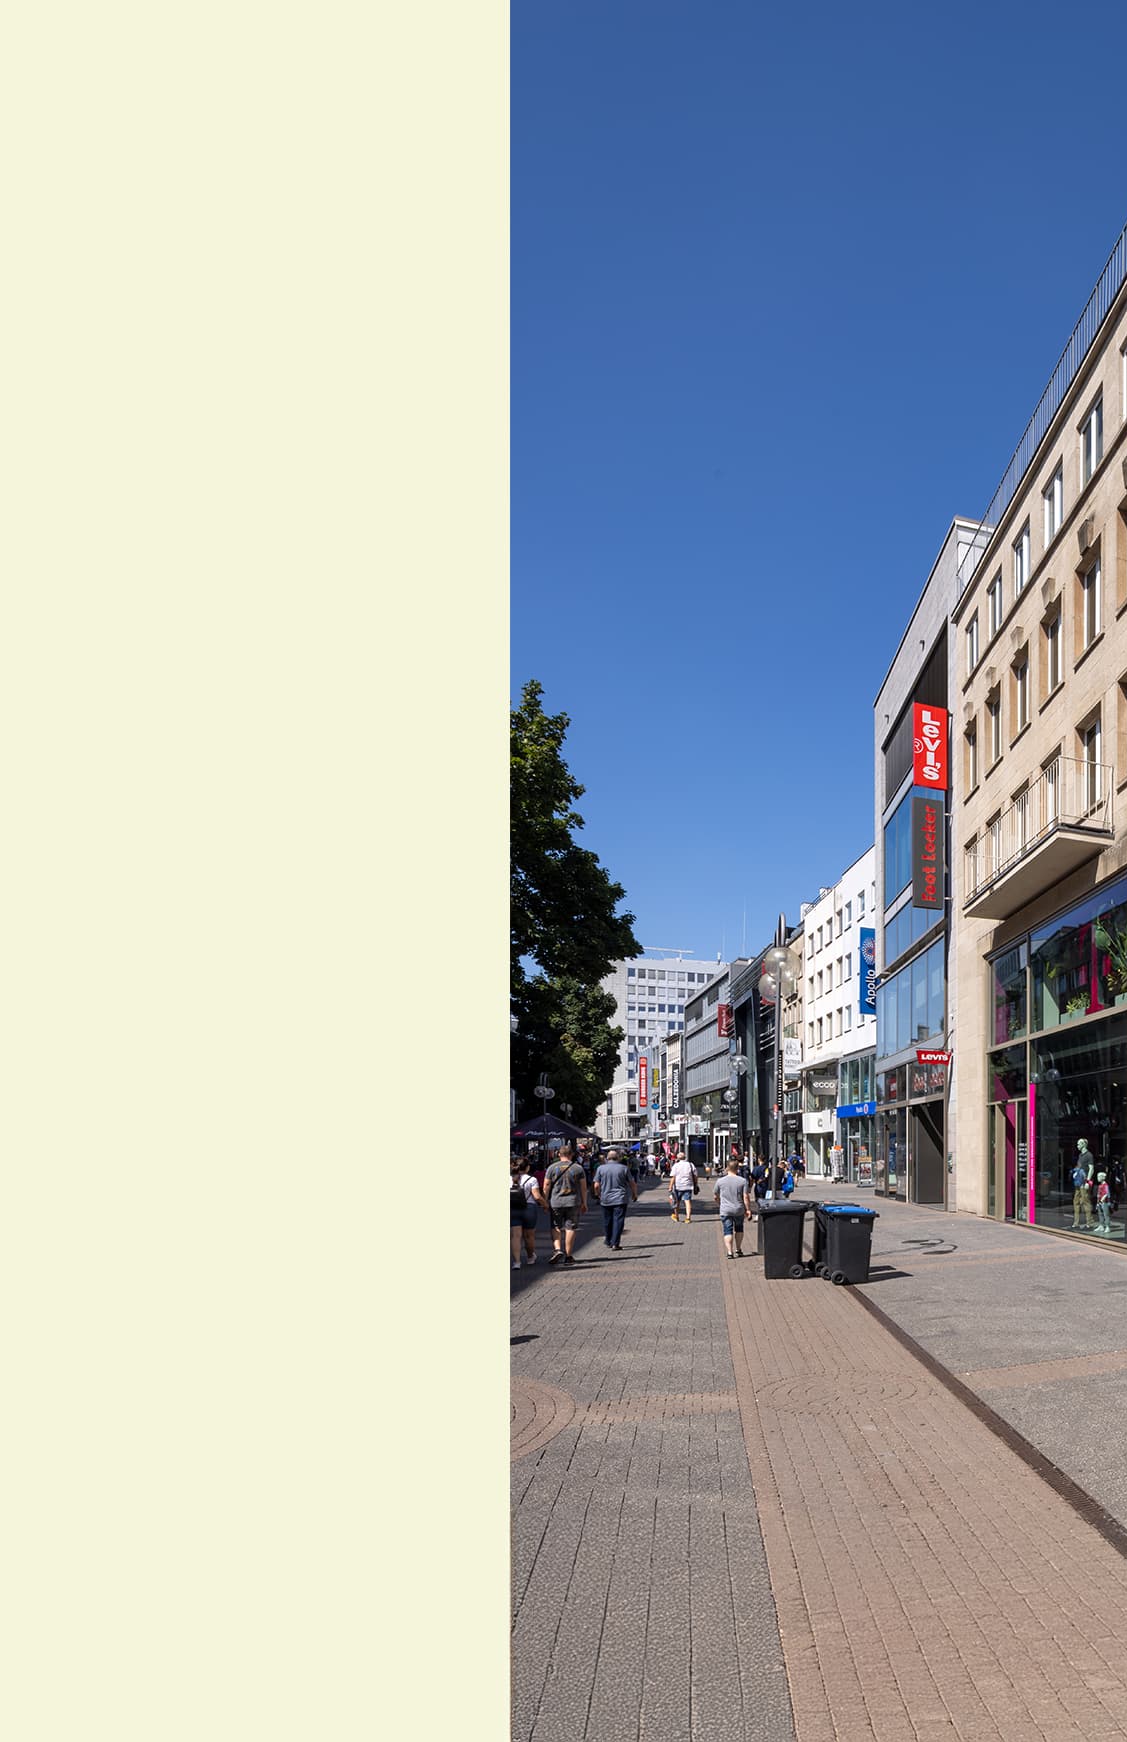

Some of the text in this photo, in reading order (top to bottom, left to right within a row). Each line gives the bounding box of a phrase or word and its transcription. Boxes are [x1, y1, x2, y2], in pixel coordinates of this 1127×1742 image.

[921, 804, 937, 902] Foot Locker
[864, 969, 877, 1006] Apollo
[813, 1081, 836, 1089] ecco
